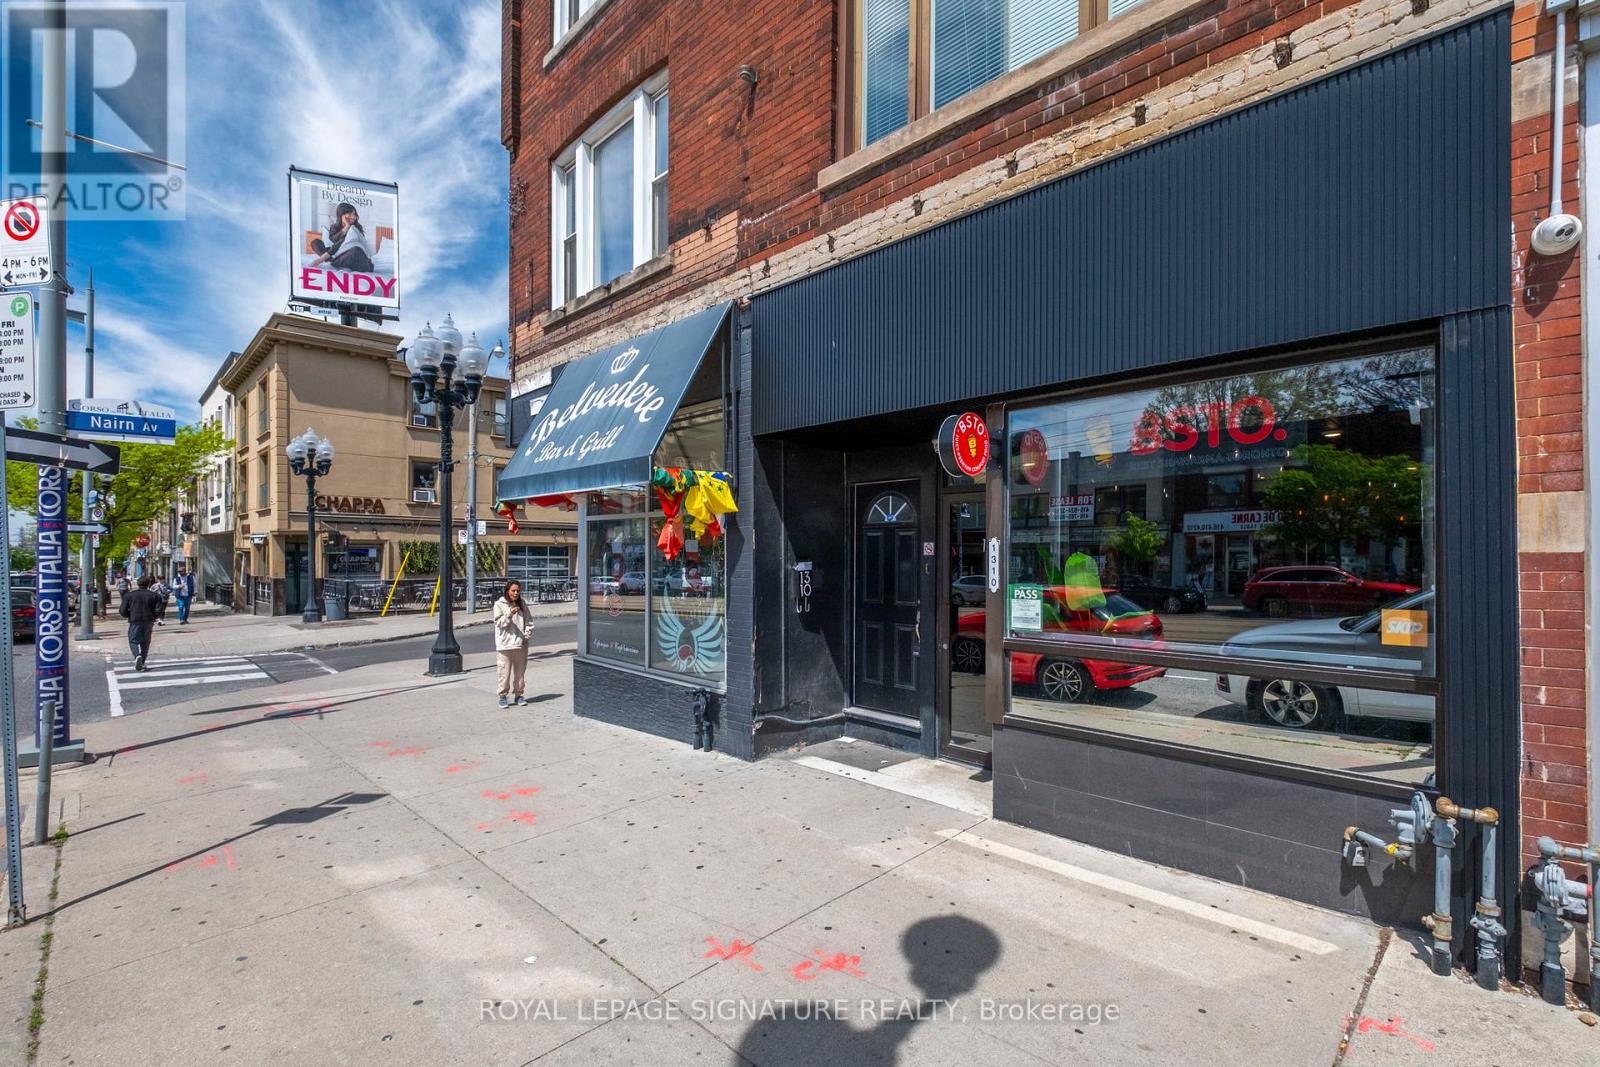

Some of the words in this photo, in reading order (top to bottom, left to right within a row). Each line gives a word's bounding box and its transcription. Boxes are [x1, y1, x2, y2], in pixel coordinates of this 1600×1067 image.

[327, 181, 368, 197] Dreamy
[322, 190, 336, 201] By
[338, 193, 373, 207] Design
[2, 258, 8, 269] 4
[10, 259, 21, 268] PM
[30, 256, 37, 267] 6
[38, 256, 49, 266] PM
[299, 267, 398, 299] ENDY
[1, 320, 15, 328] FRI
[13, 328, 24, 336] PM
[13, 338, 24, 346] PM
[13, 373, 24, 381] PM
[525, 364, 665, 423] Belvedere
[71, 402, 110, 412] CORSO
[138, 407, 172, 418] ITALIA
[90, 415, 135, 431] Nairn
[142, 421, 158, 432] Av
[958, 415, 985, 436] BSTO
[534, 441, 565, 463] Bar
[577, 424, 625, 461] Grill
[315, 495, 386, 515] CHAPPA
[38, 530, 63, 593] ITALIA
[800, 570, 811, 584] 13
[799, 583, 812, 598] 10
[1014, 589, 1038, 600] PASS
[39, 598, 64, 663] CORSO
